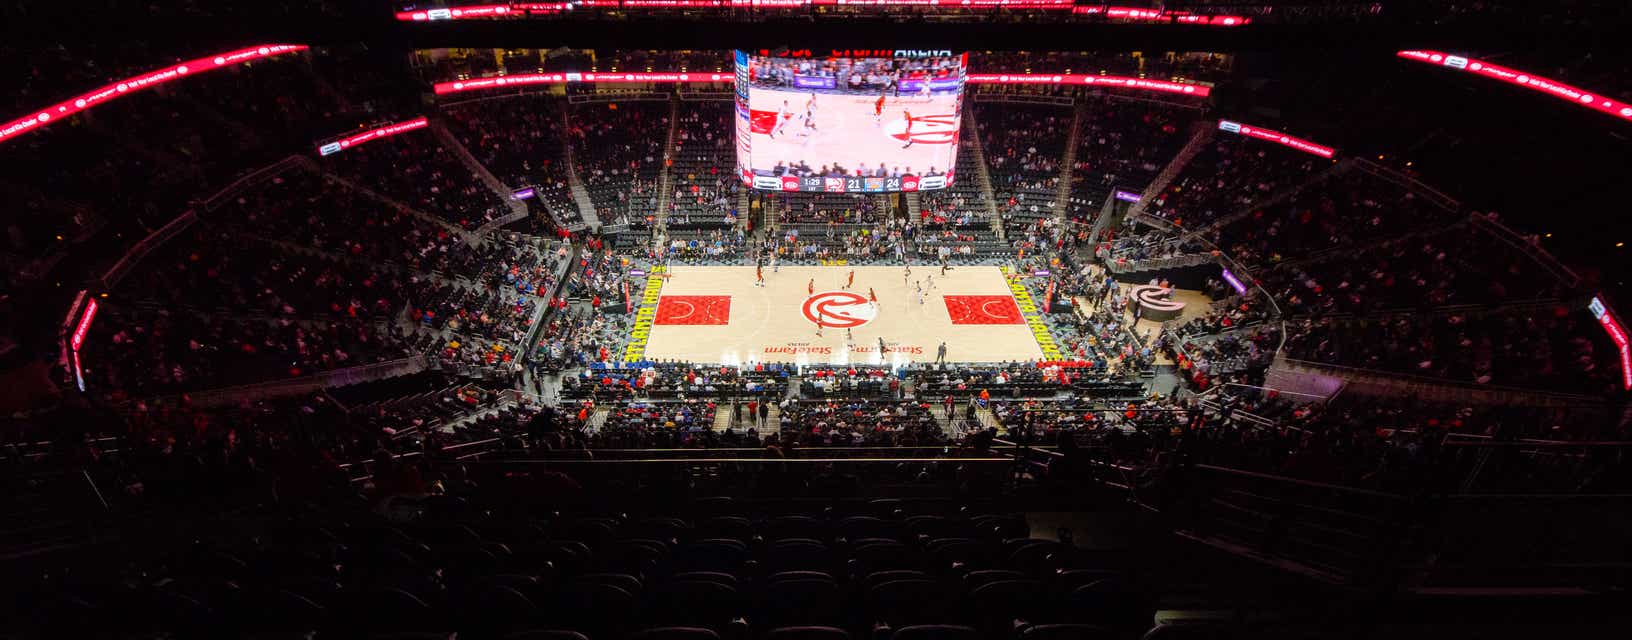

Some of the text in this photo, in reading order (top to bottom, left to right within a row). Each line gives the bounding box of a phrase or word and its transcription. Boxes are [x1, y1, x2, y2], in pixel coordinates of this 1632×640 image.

[804, 178, 820, 186] 1:29
[848, 179, 860, 189] 21
[886, 179, 899, 188] 24
[1000, 265, 1036, 312] ALANTA
